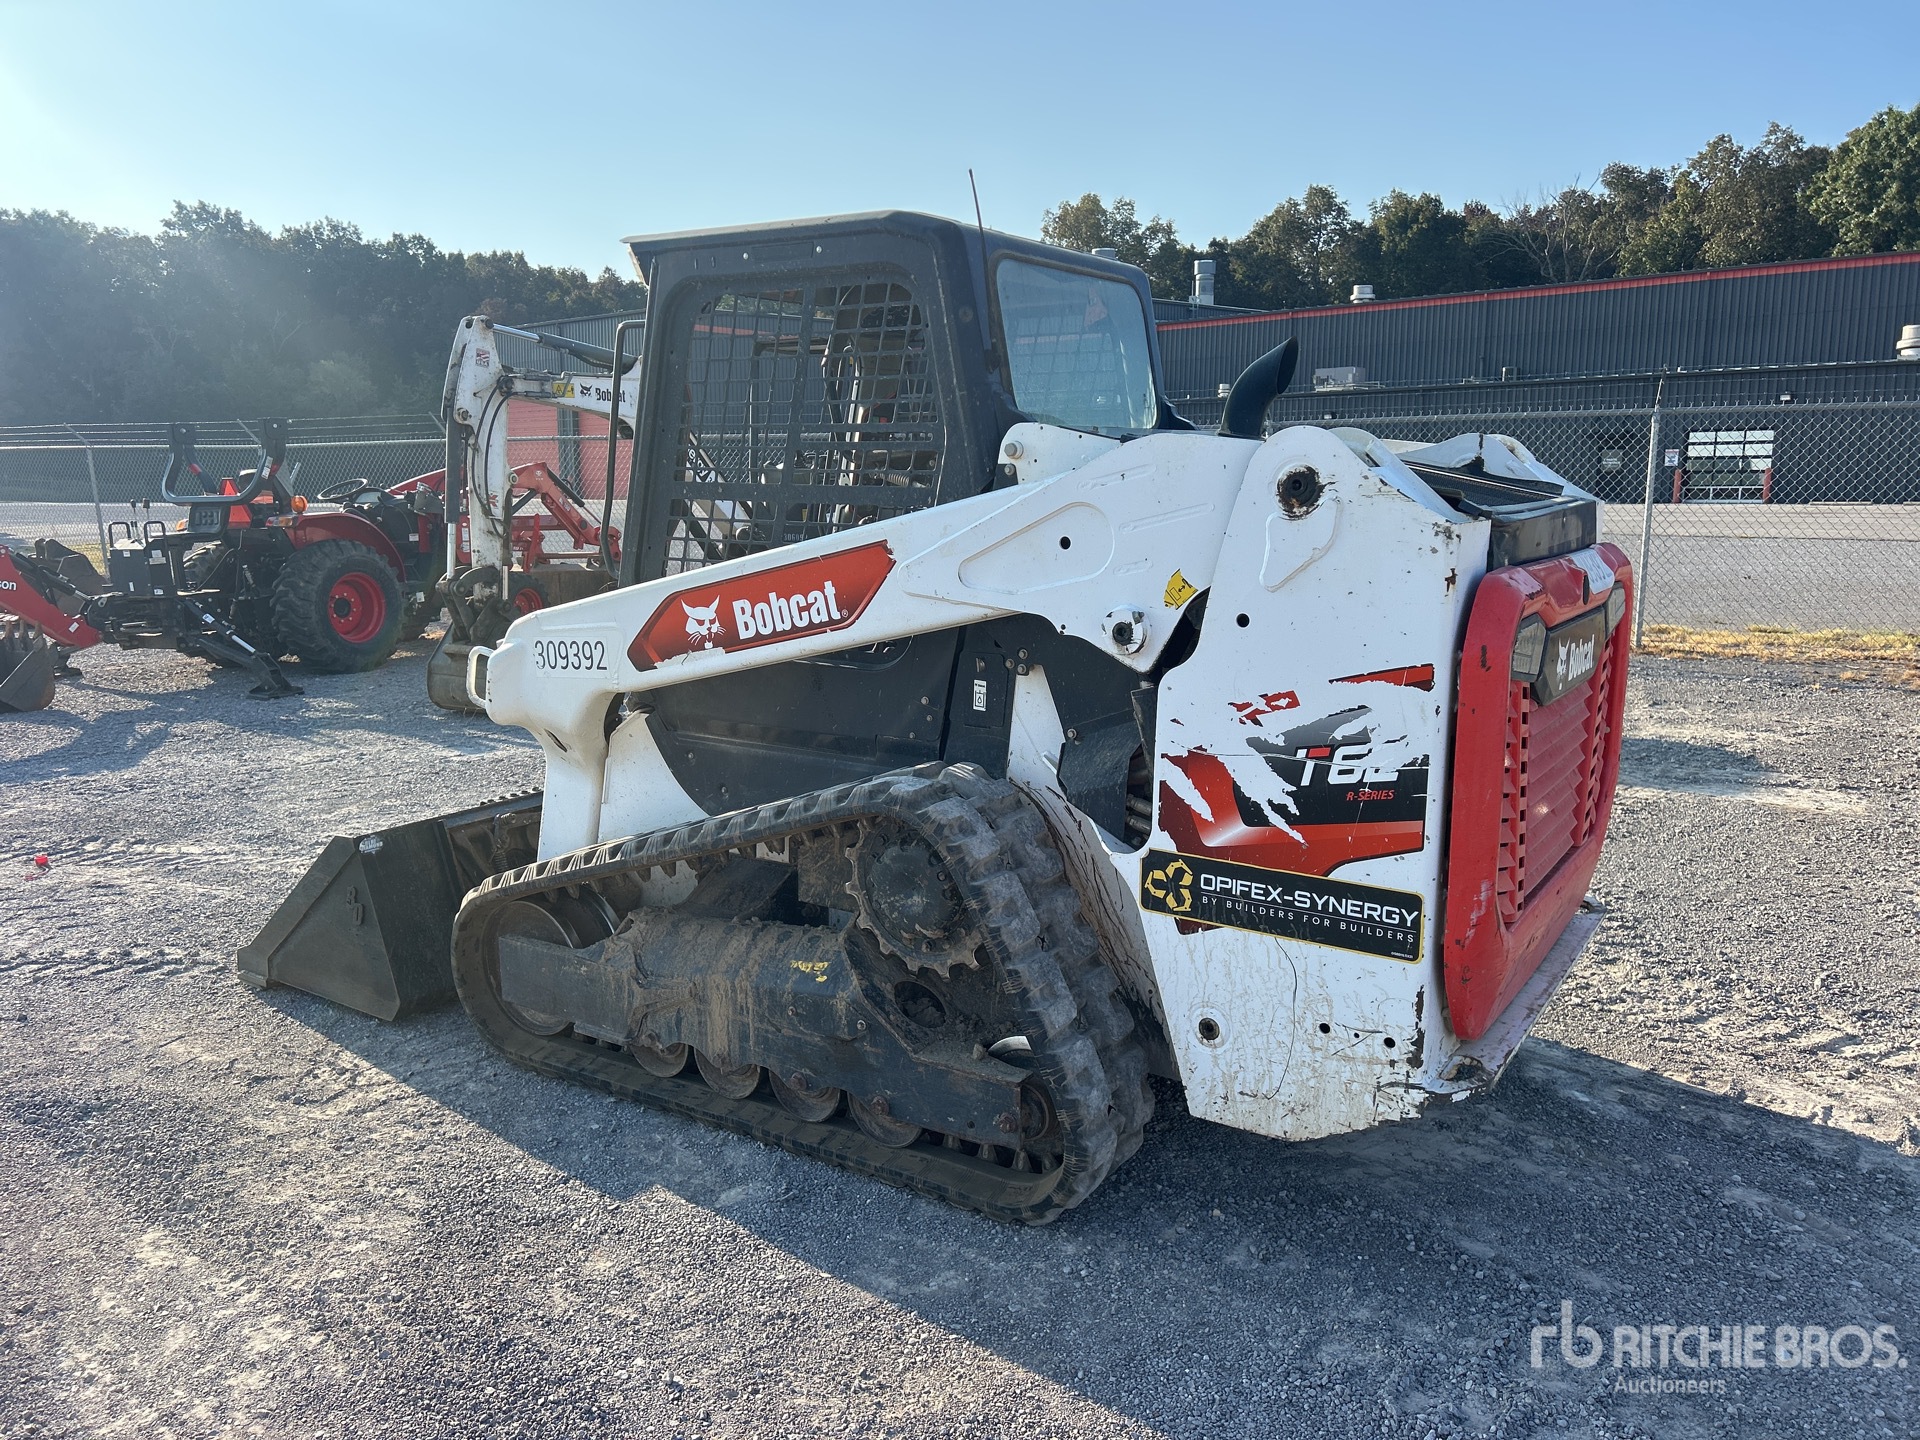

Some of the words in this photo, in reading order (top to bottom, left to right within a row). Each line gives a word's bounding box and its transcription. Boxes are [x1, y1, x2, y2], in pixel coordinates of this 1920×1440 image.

[595, 387, 626, 402] Bobat
[732, 580, 841, 640] Bobcat
[534, 639, 608, 671] 309392
[1568, 634, 1595, 681] Bobcat
[1346, 789, 1395, 801] R-SERIES
[1200, 873, 1419, 927] OPIFEX-SYNERGY
[1202, 896, 1218, 905] BY
[1226, 900, 1294, 921] BUILDERS
[1303, 915, 1330, 927] FOR
[1340, 922, 1414, 943] BUILDERS
